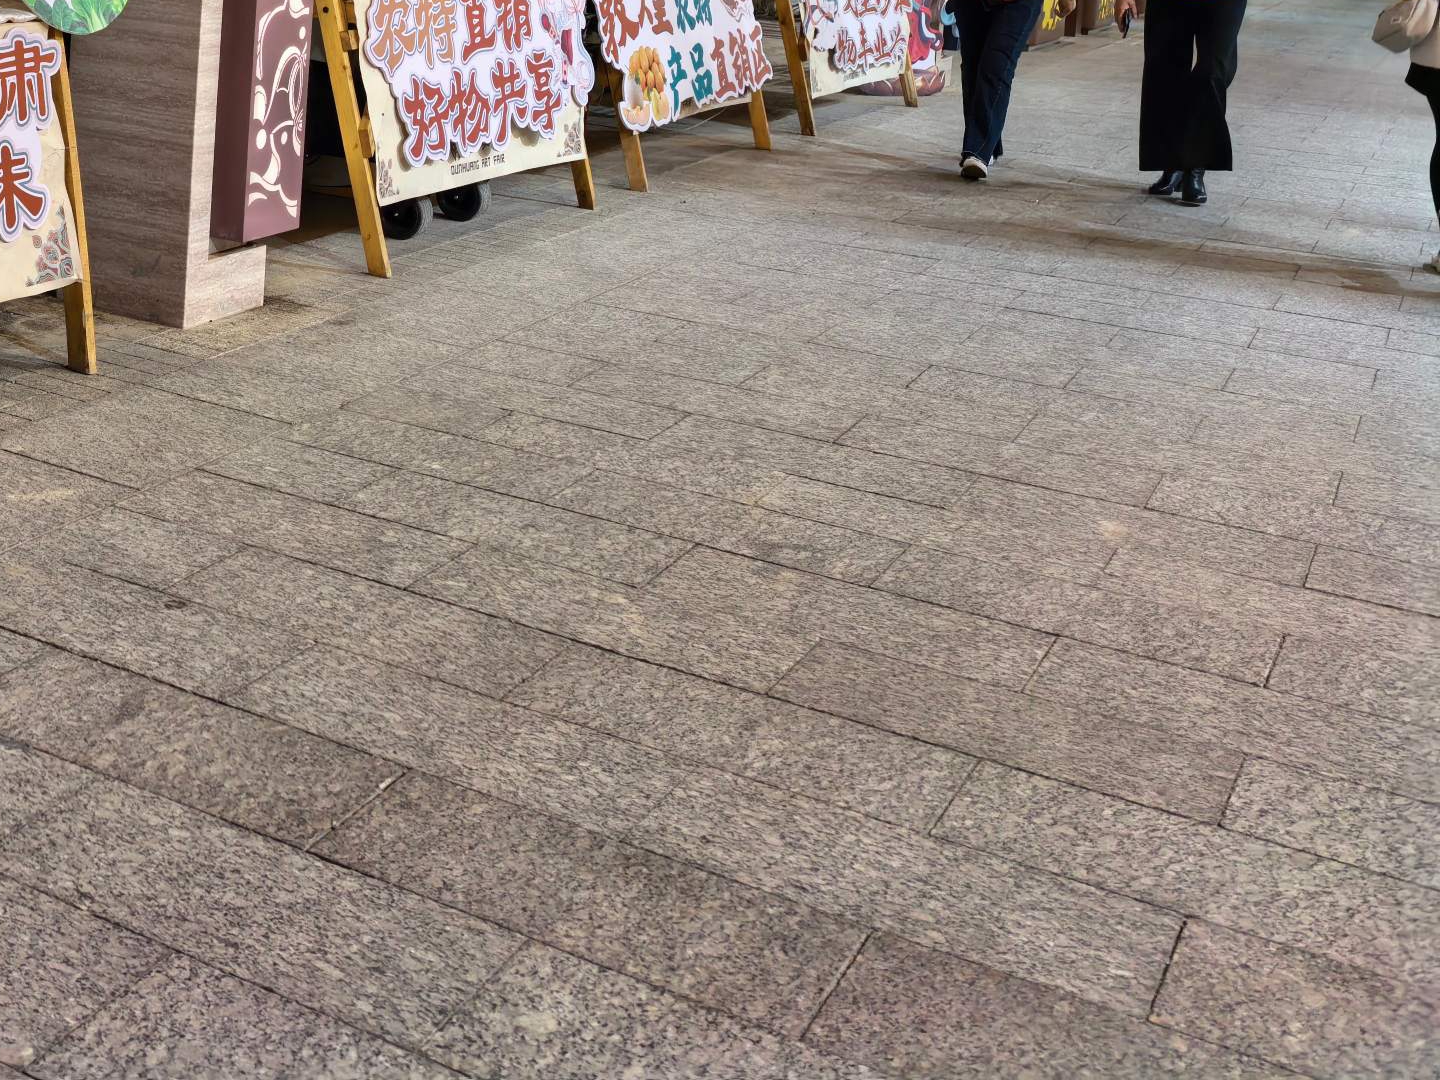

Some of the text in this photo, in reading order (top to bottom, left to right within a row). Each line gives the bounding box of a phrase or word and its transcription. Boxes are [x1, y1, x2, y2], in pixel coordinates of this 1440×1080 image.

[404, 52, 561, 159] 好物共享
[668, 24, 771, 114] 产品直销区
